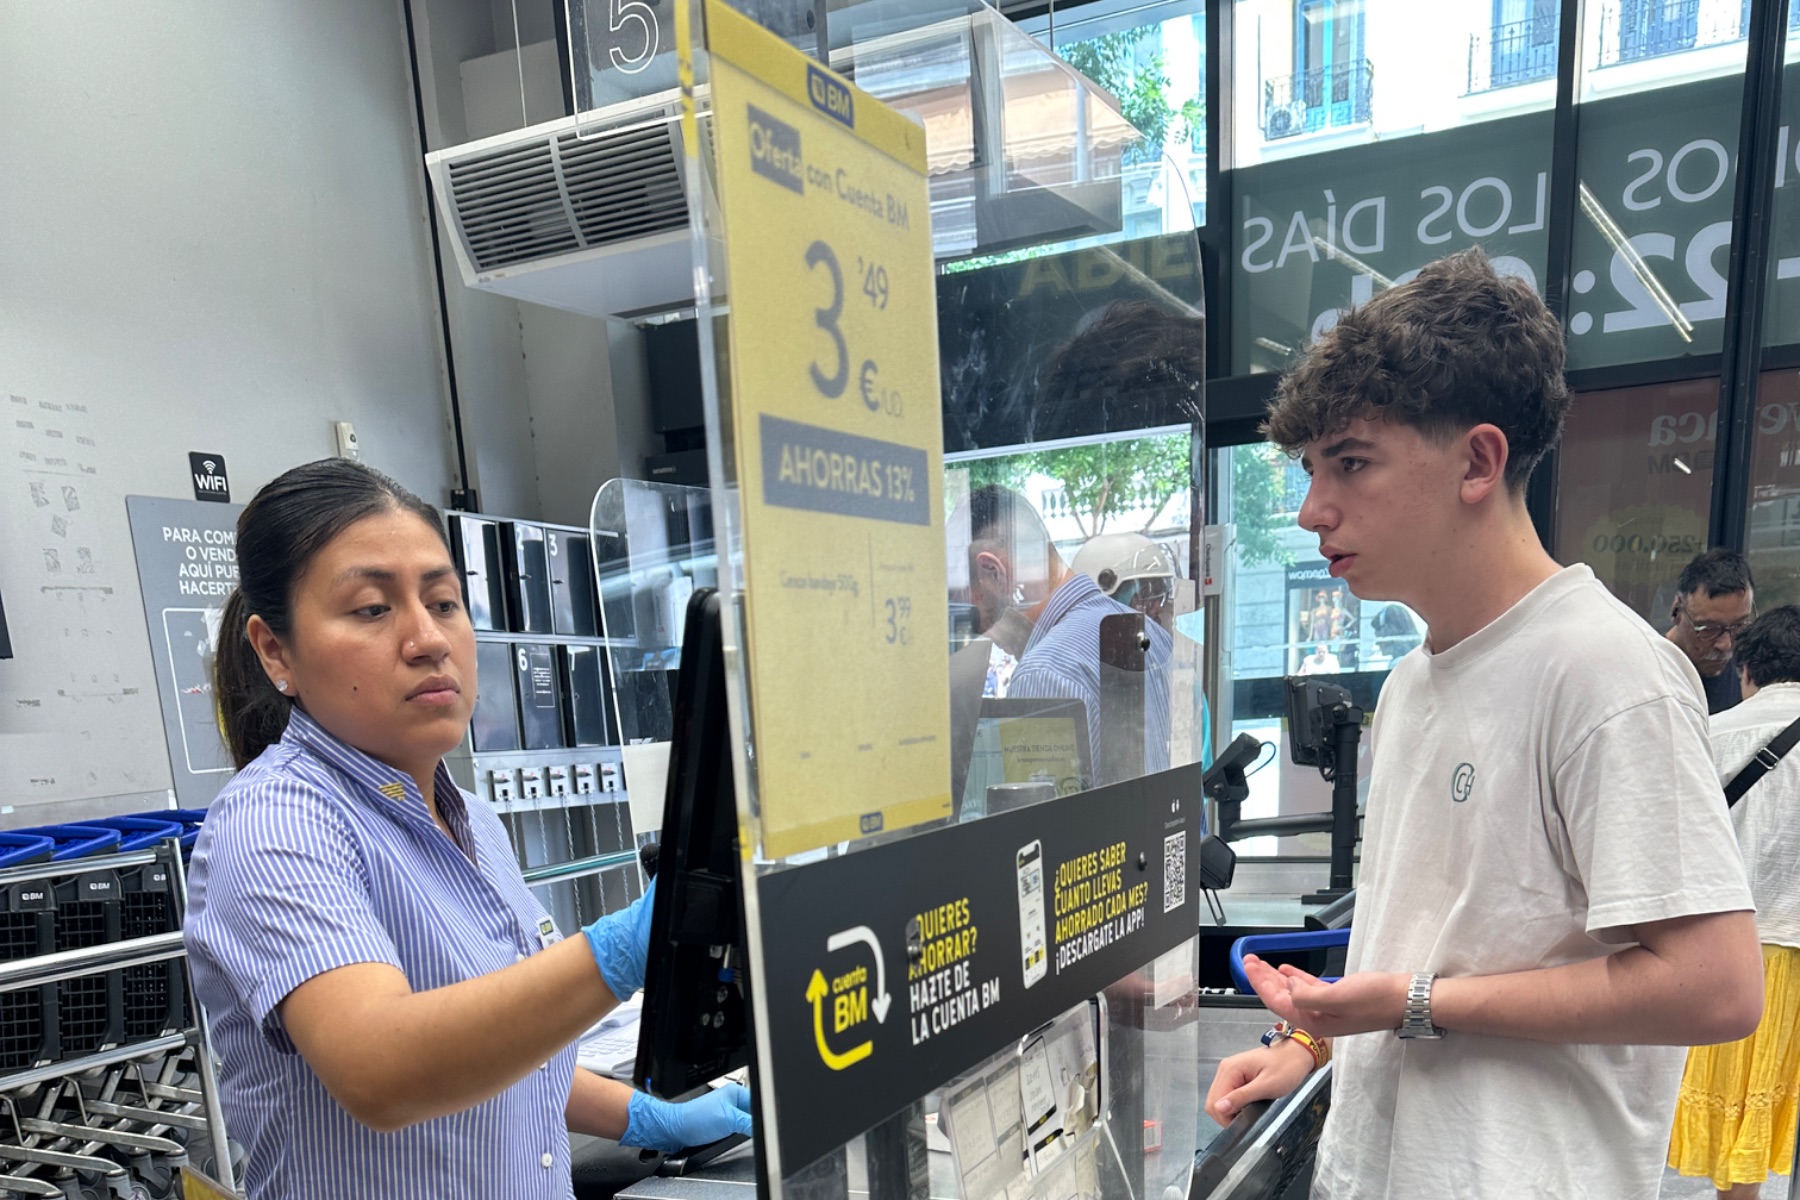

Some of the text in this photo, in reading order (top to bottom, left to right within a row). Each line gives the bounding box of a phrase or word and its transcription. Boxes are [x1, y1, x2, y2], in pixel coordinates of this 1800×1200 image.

[609, 0, 659, 74] 5
[827, 84, 850, 120] BM
[750, 122, 910, 231] Oferta con Cuenta BM
[805, 240, 850, 399] 3
[195, 473, 227, 491] WIFI
[778, 444, 915, 503] AHORRAS 13%
[162, 527, 237, 545] PARA COM
[516, 529, 524, 550] 2
[549, 534, 558, 556] 3
[179, 561, 240, 578] AQUÍ PUE
[186, 546, 238, 562] O VEND
[518, 648, 528, 671] 6
[1055, 841, 1126, 892] ¿QUIERES SABER
[1093, 868, 1122, 901] LLEVAS
[1055, 881, 1148, 944] AHORRADO CADA MES?
[1115, 915, 1125, 941] LA
[1126, 907, 1145, 935] APP!
[832, 965, 867, 994] cuenta
[910, 960, 970, 1013] HAZTE DE
[834, 986, 868, 1034] BM
[912, 977, 1000, 1045] LA CUENTA BM
